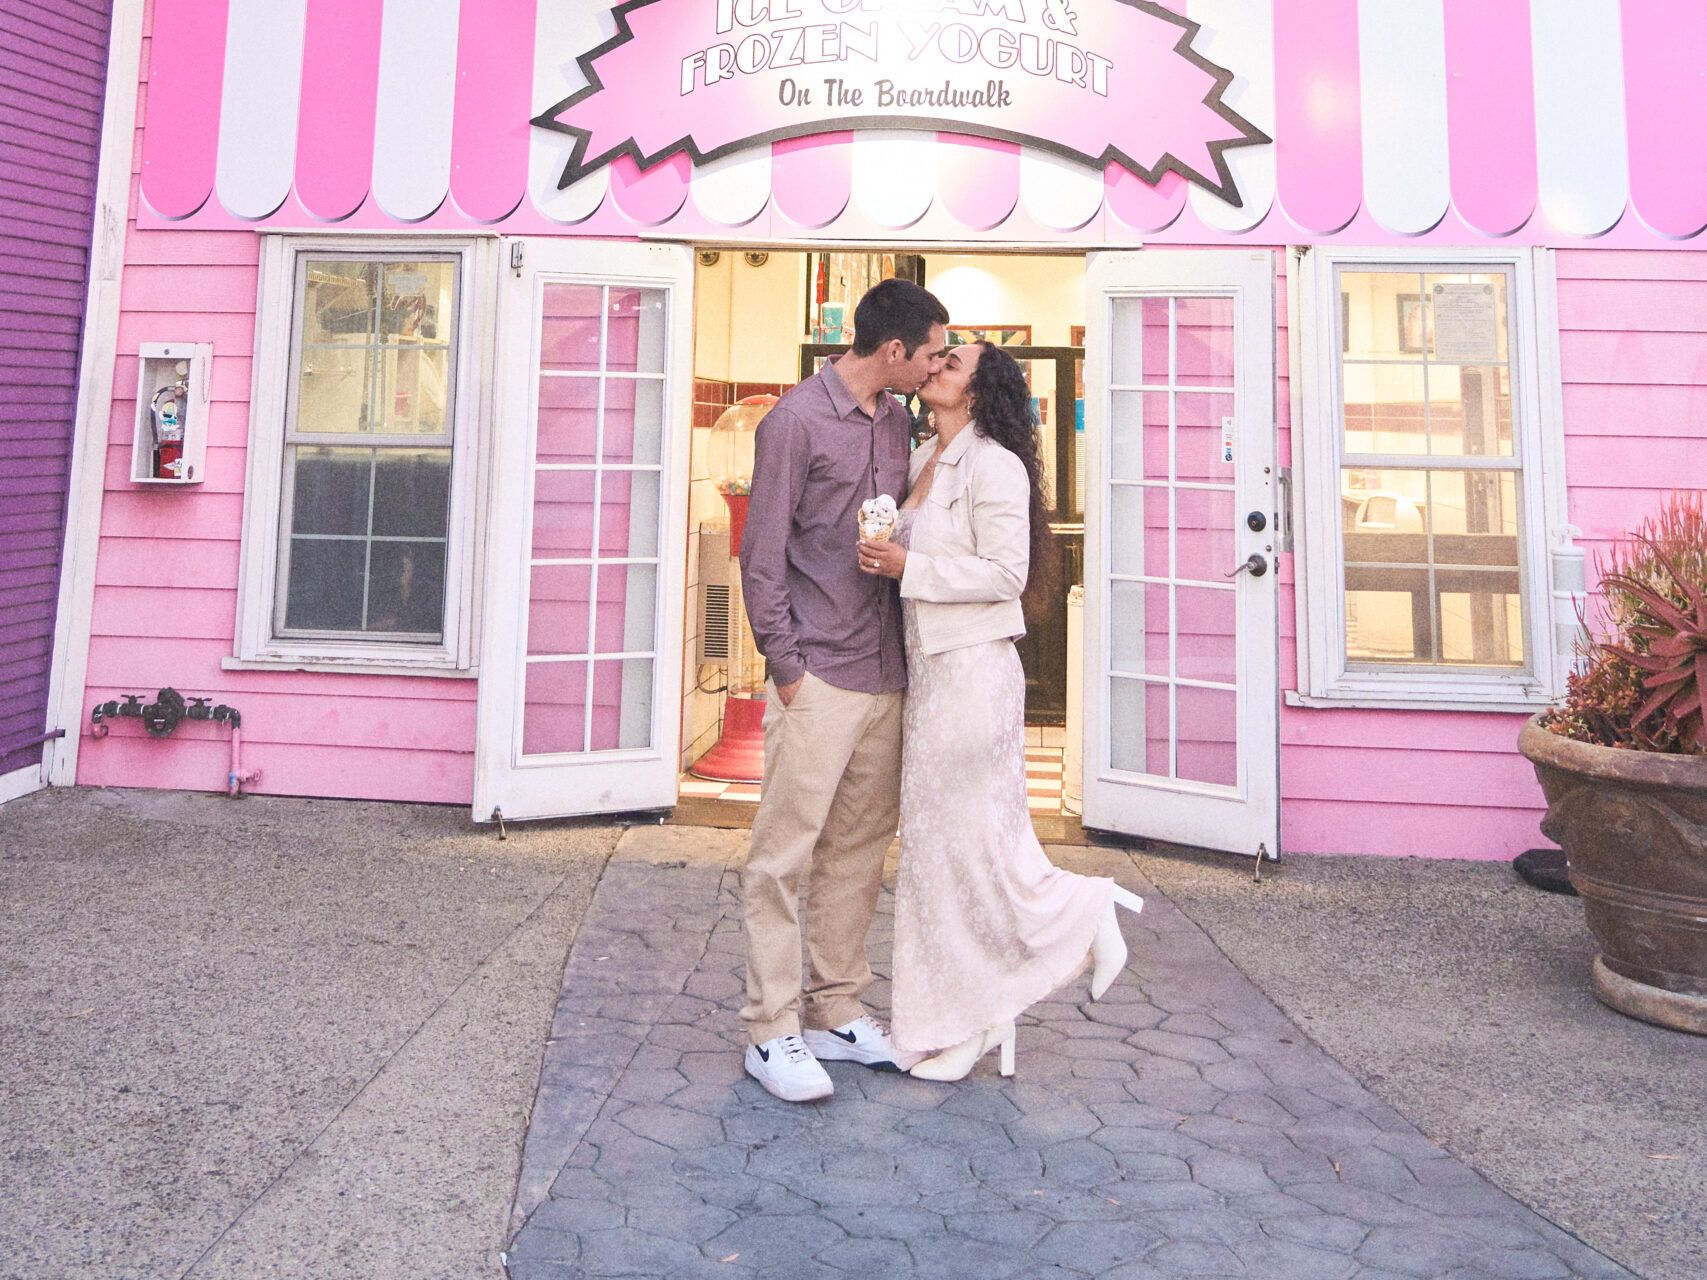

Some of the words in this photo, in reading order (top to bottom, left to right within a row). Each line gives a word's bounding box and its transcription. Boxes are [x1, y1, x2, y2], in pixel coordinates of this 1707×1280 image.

[680, 21, 879, 97] FROZEN
[896, 21, 1114, 98] YOGURT
[778, 78, 812, 107] On
[823, 78, 864, 107] The
[874, 79, 1013, 108] Boardwalk
